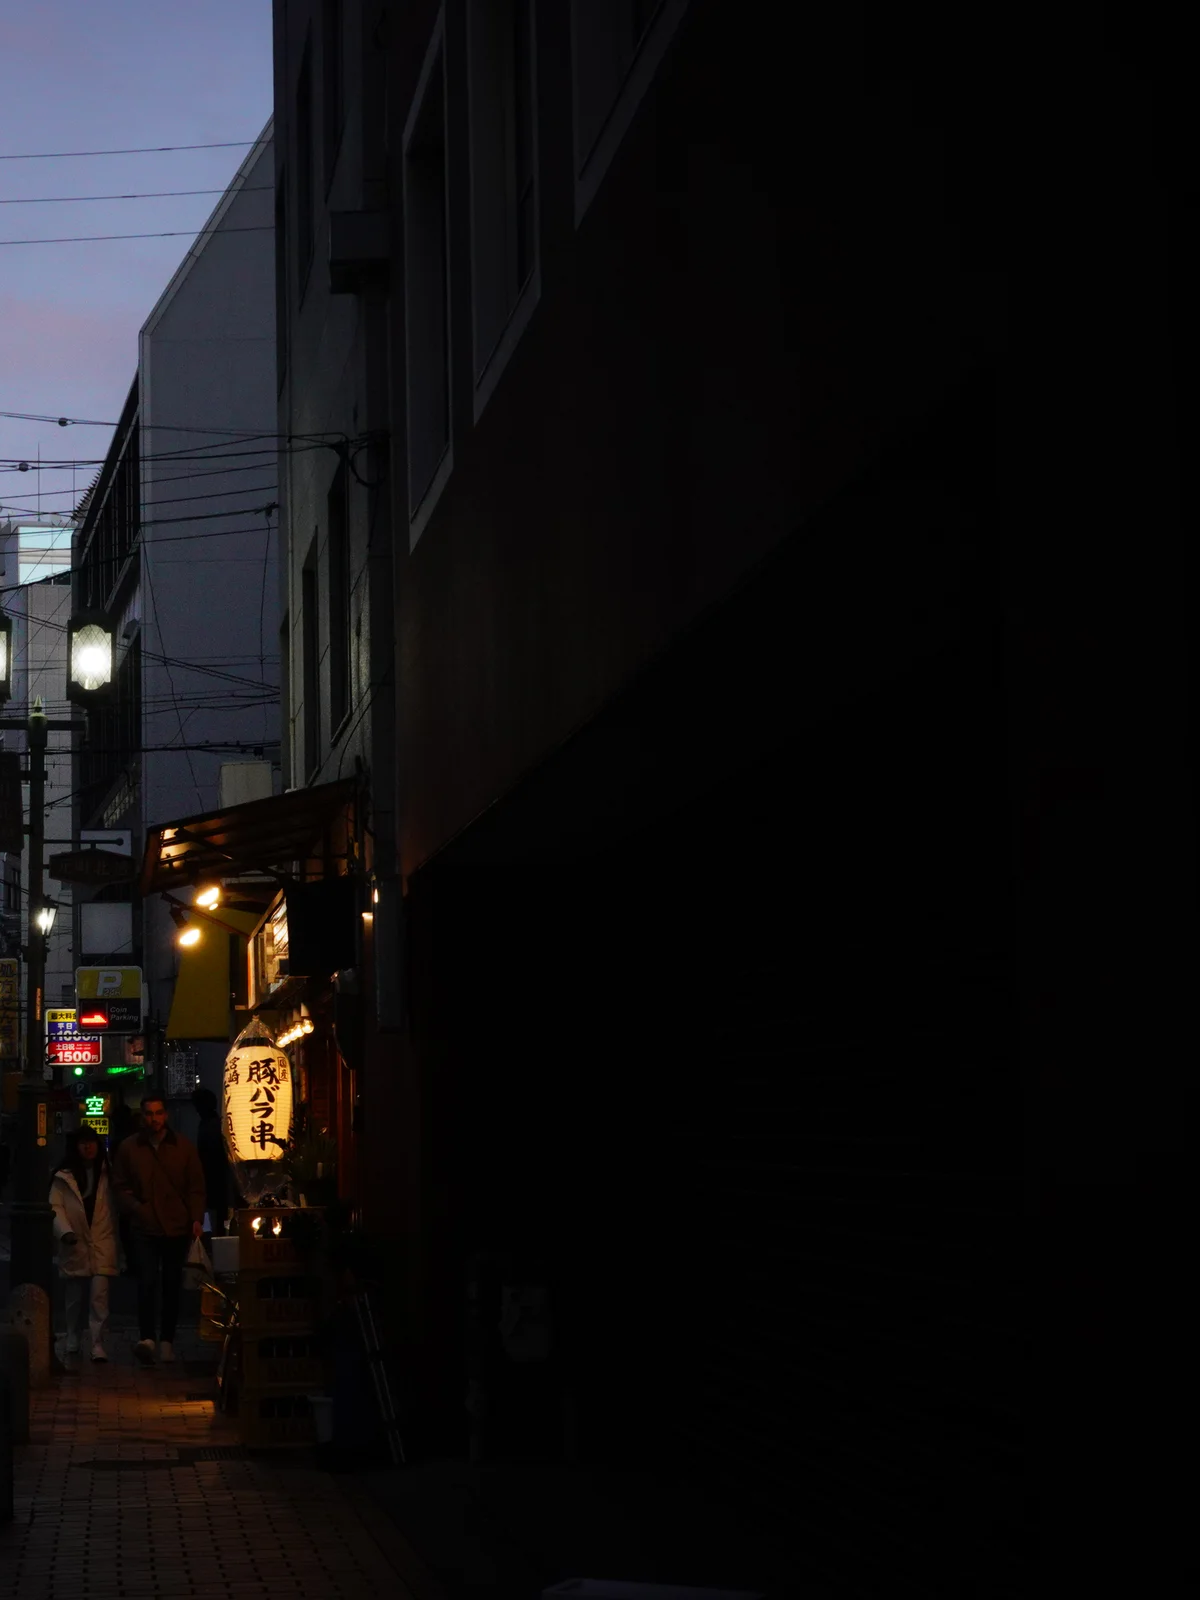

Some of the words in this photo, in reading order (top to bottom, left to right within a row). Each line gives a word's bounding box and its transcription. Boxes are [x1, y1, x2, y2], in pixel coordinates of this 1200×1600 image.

[109, 1014, 139, 1022] Parking
[85, 1095, 105, 1116] 空
[246, 1058, 281, 1151] 豚バラ串
